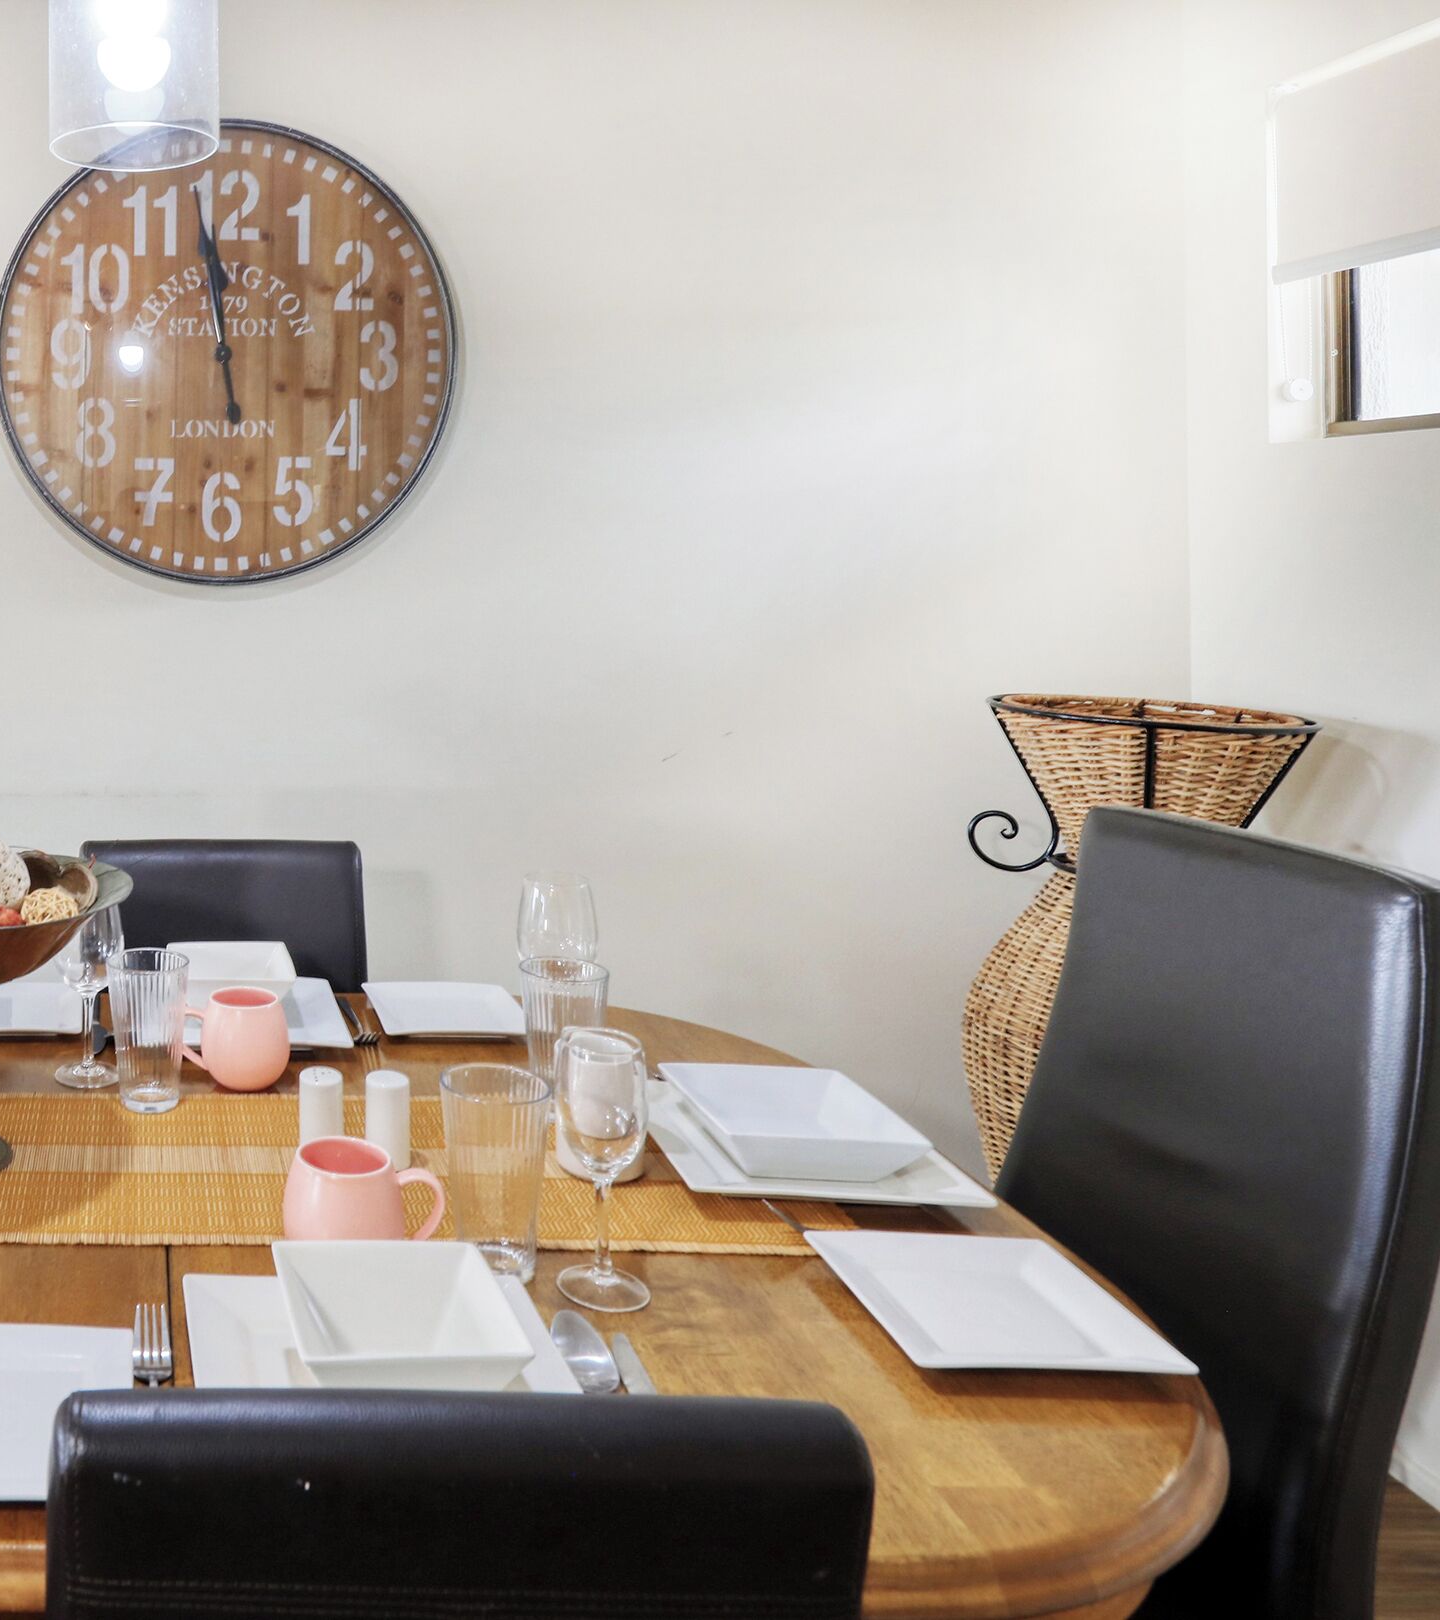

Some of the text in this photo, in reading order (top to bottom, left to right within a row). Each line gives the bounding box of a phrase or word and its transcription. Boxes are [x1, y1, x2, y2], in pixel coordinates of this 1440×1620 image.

[122, 185, 178, 257] 11
[189, 170, 260, 241] 12
[286, 194, 311, 265] 1
[61, 243, 130, 314] 10
[131, 260, 316, 338] KENSNGTON
[200, 295, 248, 314] 179
[334, 241, 374, 311] 2
[51, 319, 92, 390] 9
[360, 320, 398, 392] 3
[76, 398, 116, 469] 8
[170, 419, 275, 438] LONDON
[326, 399, 367, 471] 4
[134, 458, 175, 526] 7
[202, 472, 241, 543] 6
[273, 457, 313, 526] 5
